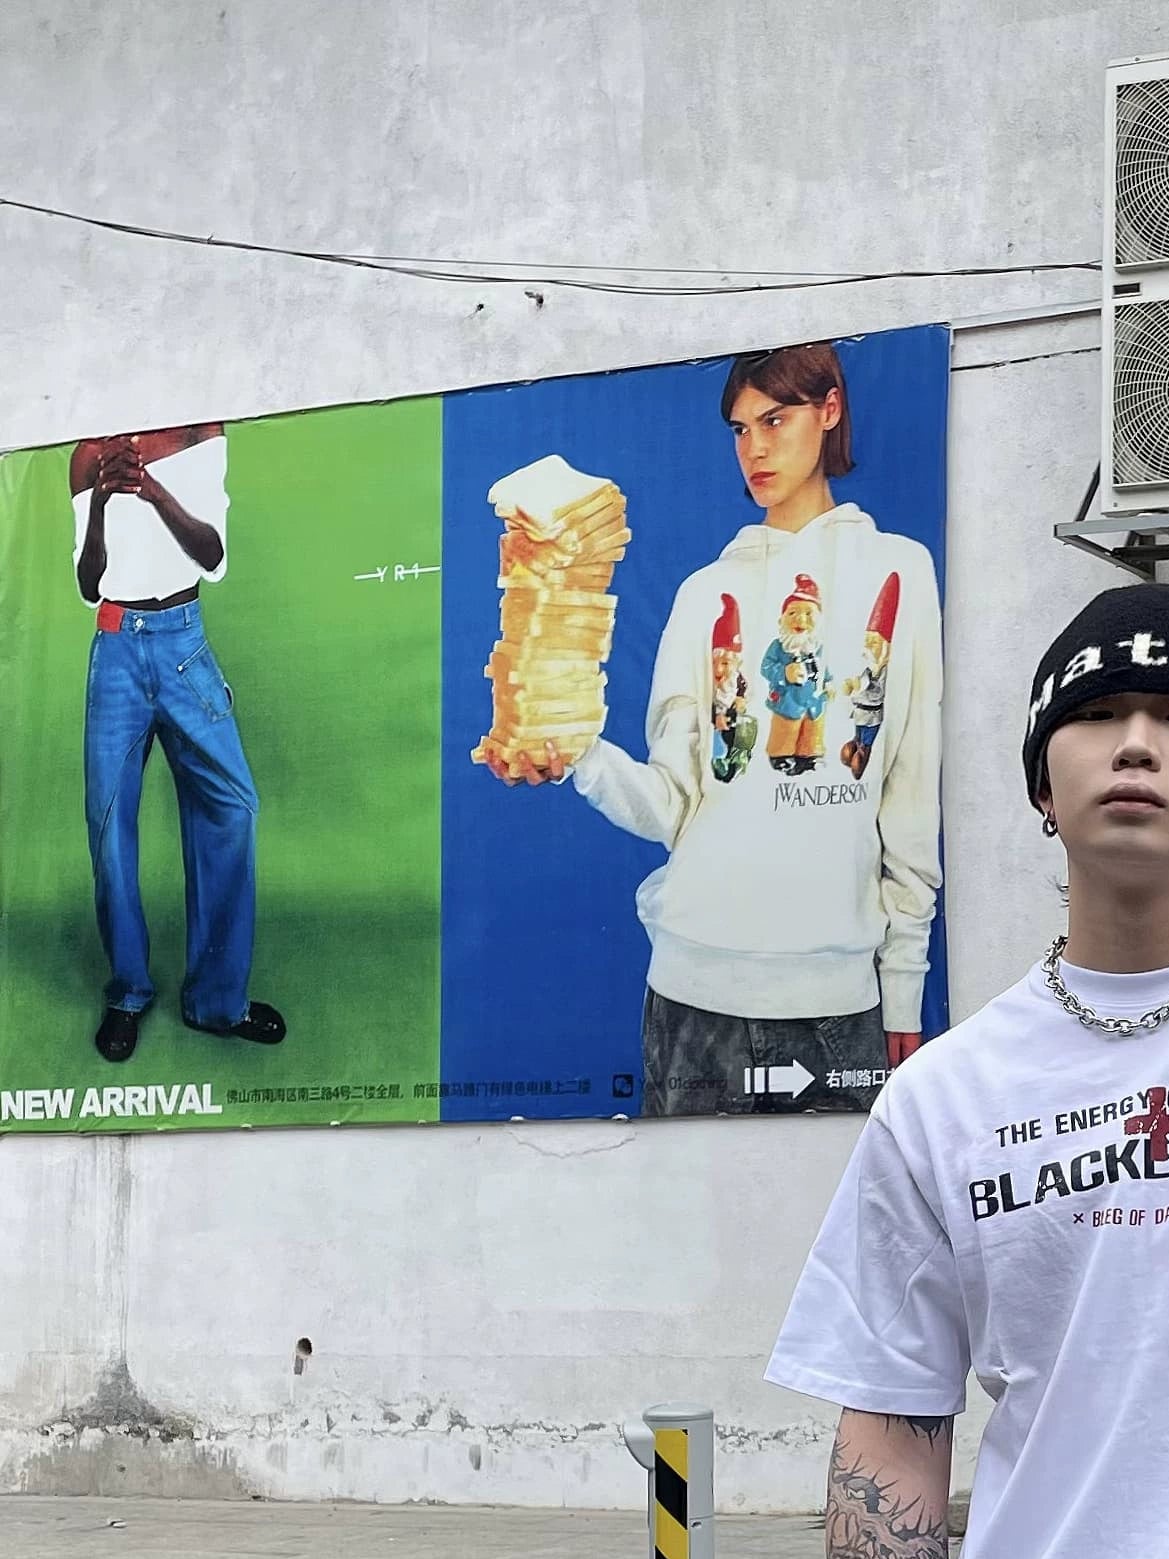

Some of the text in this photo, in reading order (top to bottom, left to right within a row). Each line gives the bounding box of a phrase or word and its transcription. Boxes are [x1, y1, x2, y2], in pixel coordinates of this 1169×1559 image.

[826, 1067, 895, 1088] 右侧路口
[0, 1083, 223, 1120] NEW ARRIVAL
[995, 1113, 1042, 1147] THE
[1056, 1091, 1150, 1136] ENERGY
[1129, 1209, 1146, 1226] OF
